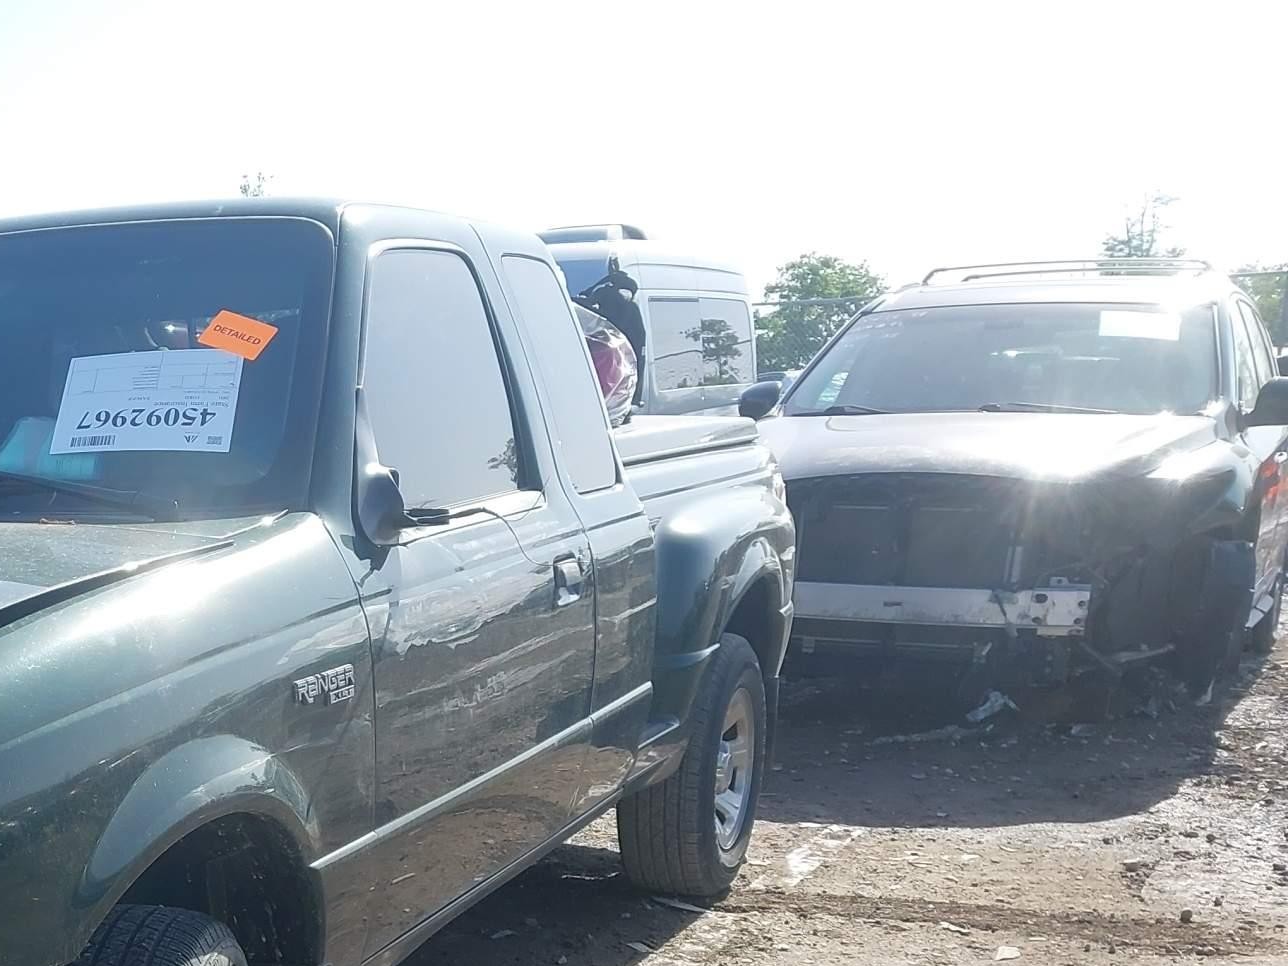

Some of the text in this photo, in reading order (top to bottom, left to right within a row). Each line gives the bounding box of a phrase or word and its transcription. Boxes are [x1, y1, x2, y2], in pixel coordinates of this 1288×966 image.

[213, 324, 262, 346] DETAILED
[76, 407, 217, 430] 45092967
[294, 664, 355, 703] RANGER
